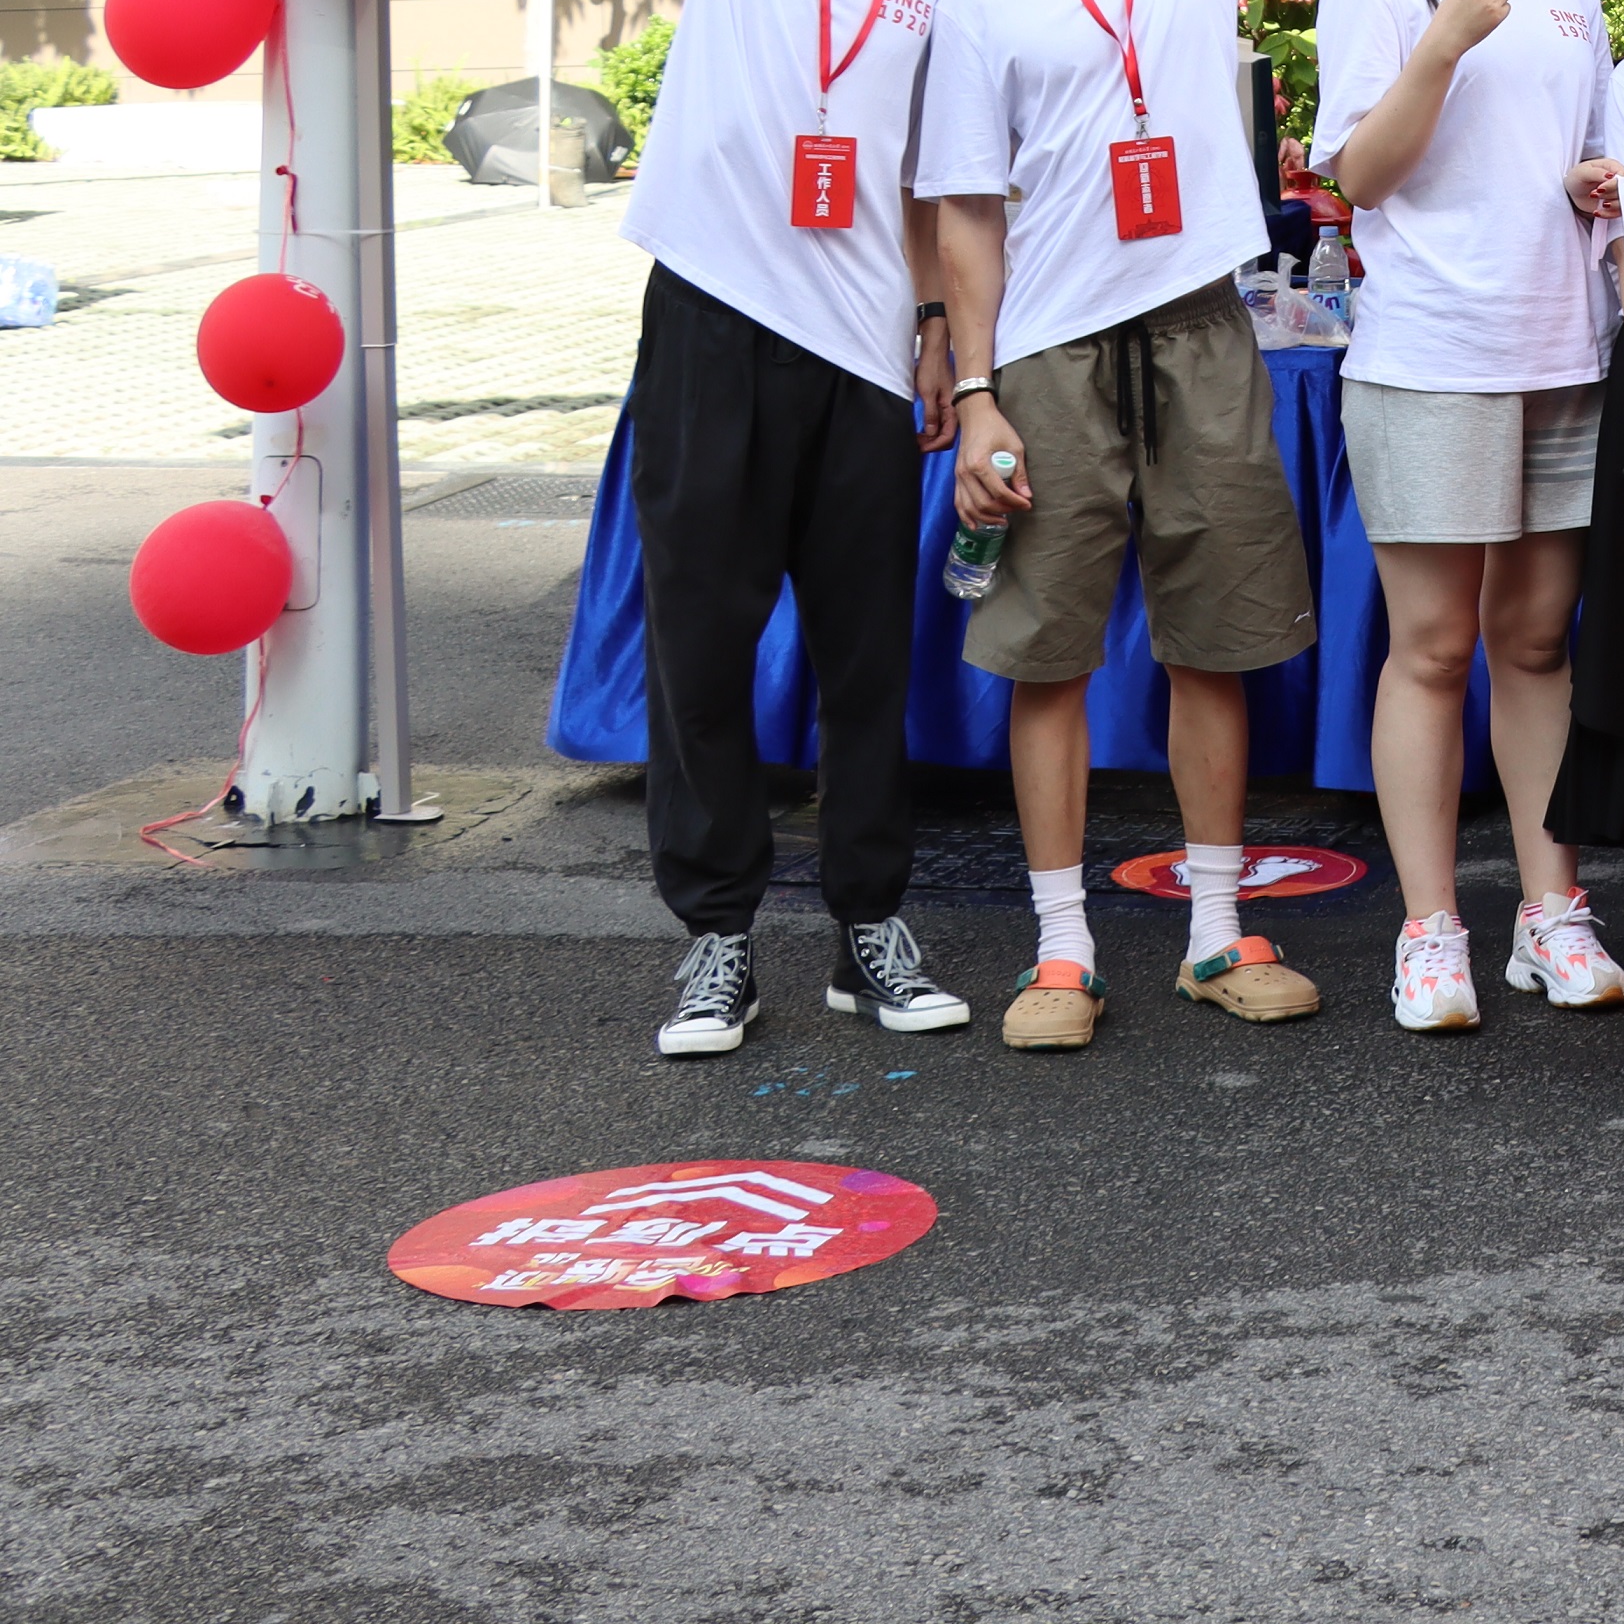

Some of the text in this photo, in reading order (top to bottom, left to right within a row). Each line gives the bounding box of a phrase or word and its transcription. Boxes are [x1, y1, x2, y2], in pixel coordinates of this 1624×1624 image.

[877, 4, 927, 37] 1920
[1549, 8, 1588, 29] SINCE
[815, 163, 832, 217] 工作人员
